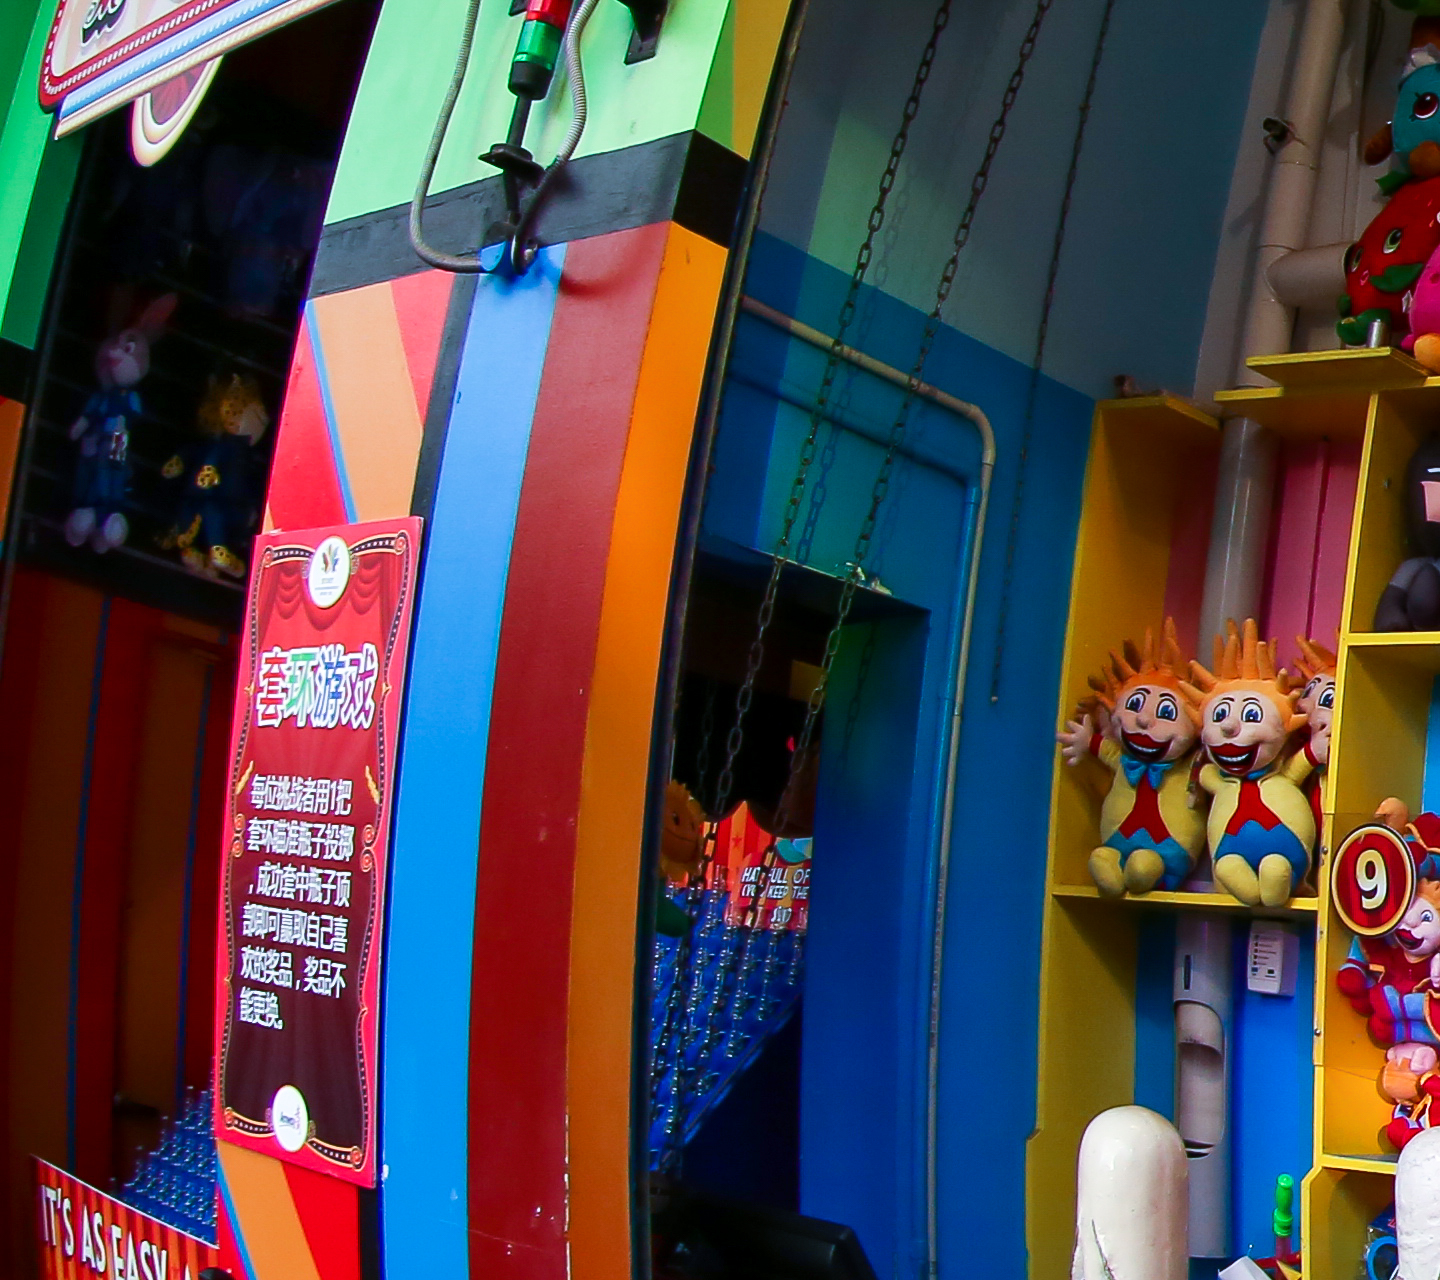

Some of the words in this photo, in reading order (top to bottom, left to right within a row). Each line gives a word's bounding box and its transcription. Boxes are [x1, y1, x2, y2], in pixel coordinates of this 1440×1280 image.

[256, 642, 378, 729] 套环游戏
[1355, 849, 1385, 910] 9
[41, 1185, 75, 1258] IT'S
[81, 1204, 107, 1273] AS
